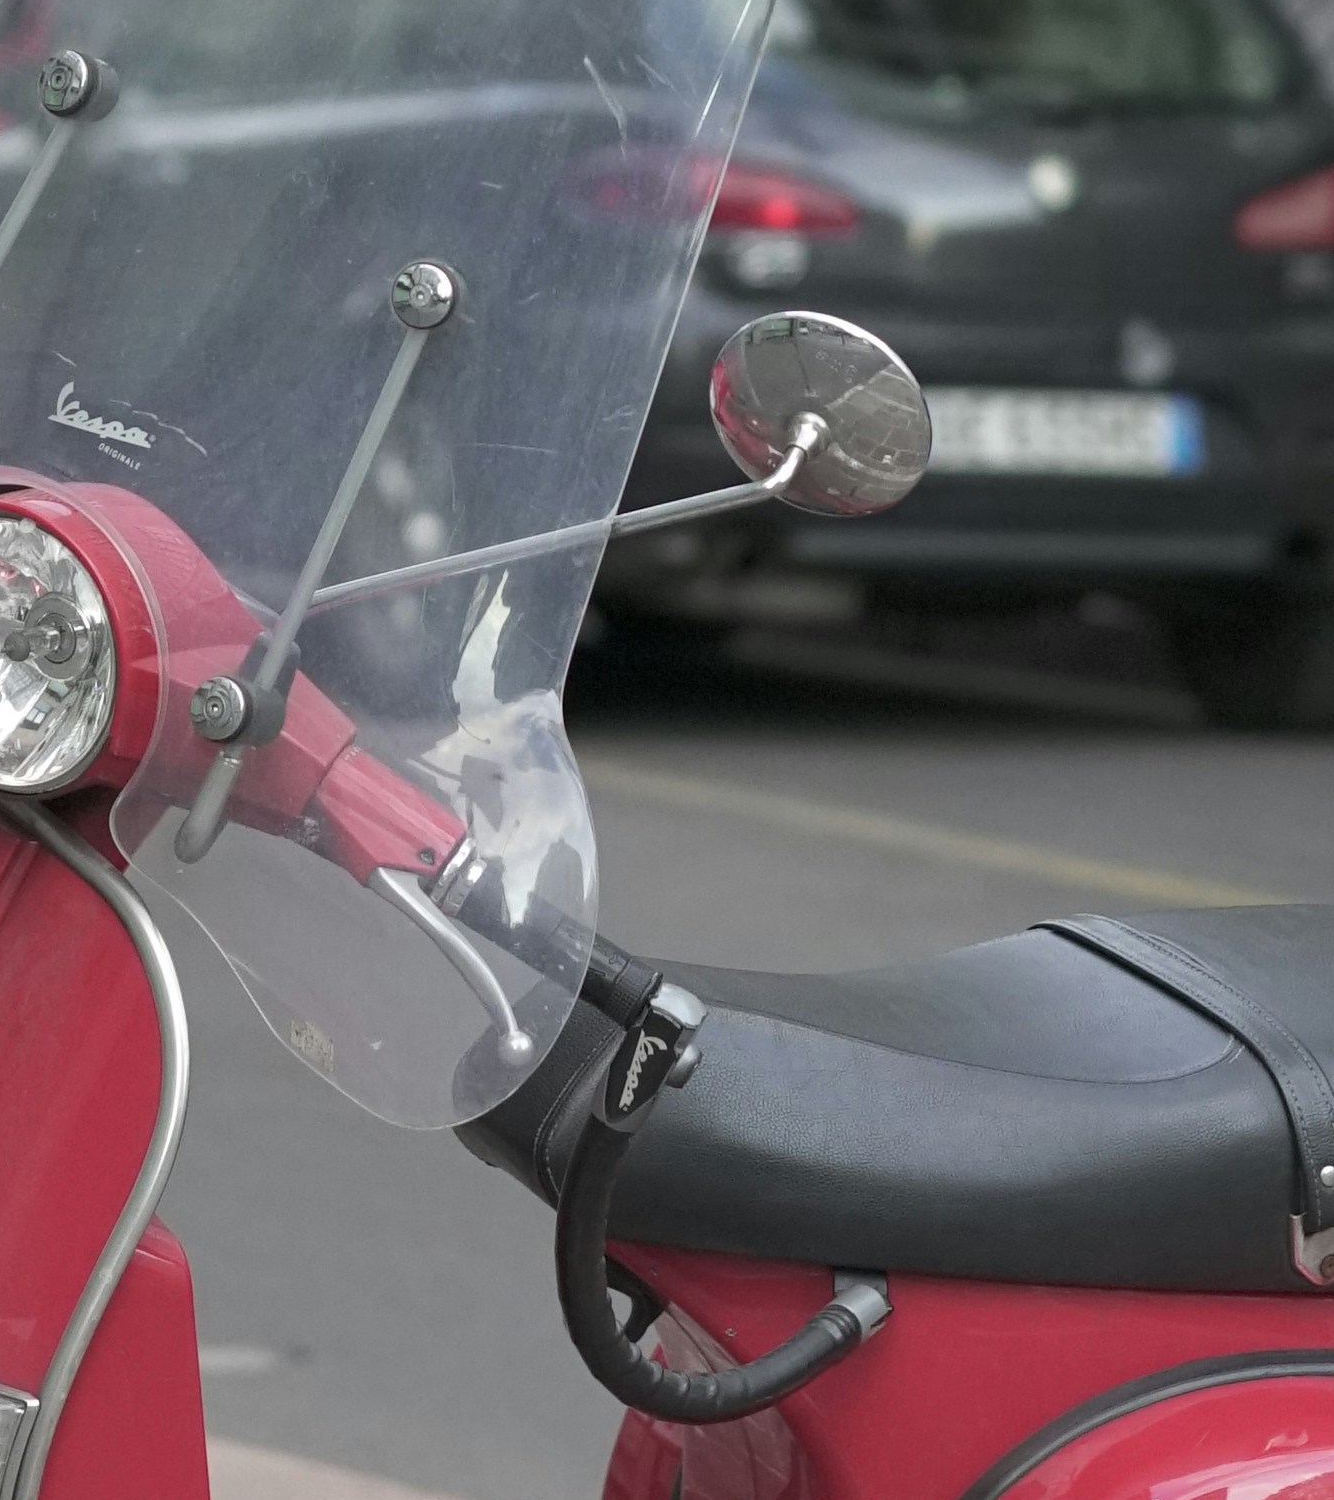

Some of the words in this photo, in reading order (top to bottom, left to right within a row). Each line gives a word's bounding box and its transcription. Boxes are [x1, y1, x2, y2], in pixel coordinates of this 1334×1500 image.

[48, 381, 152, 449] Vespa
[98, 442, 142, 471] ORIGINALE
[619, 1028, 667, 1109] Vespa
